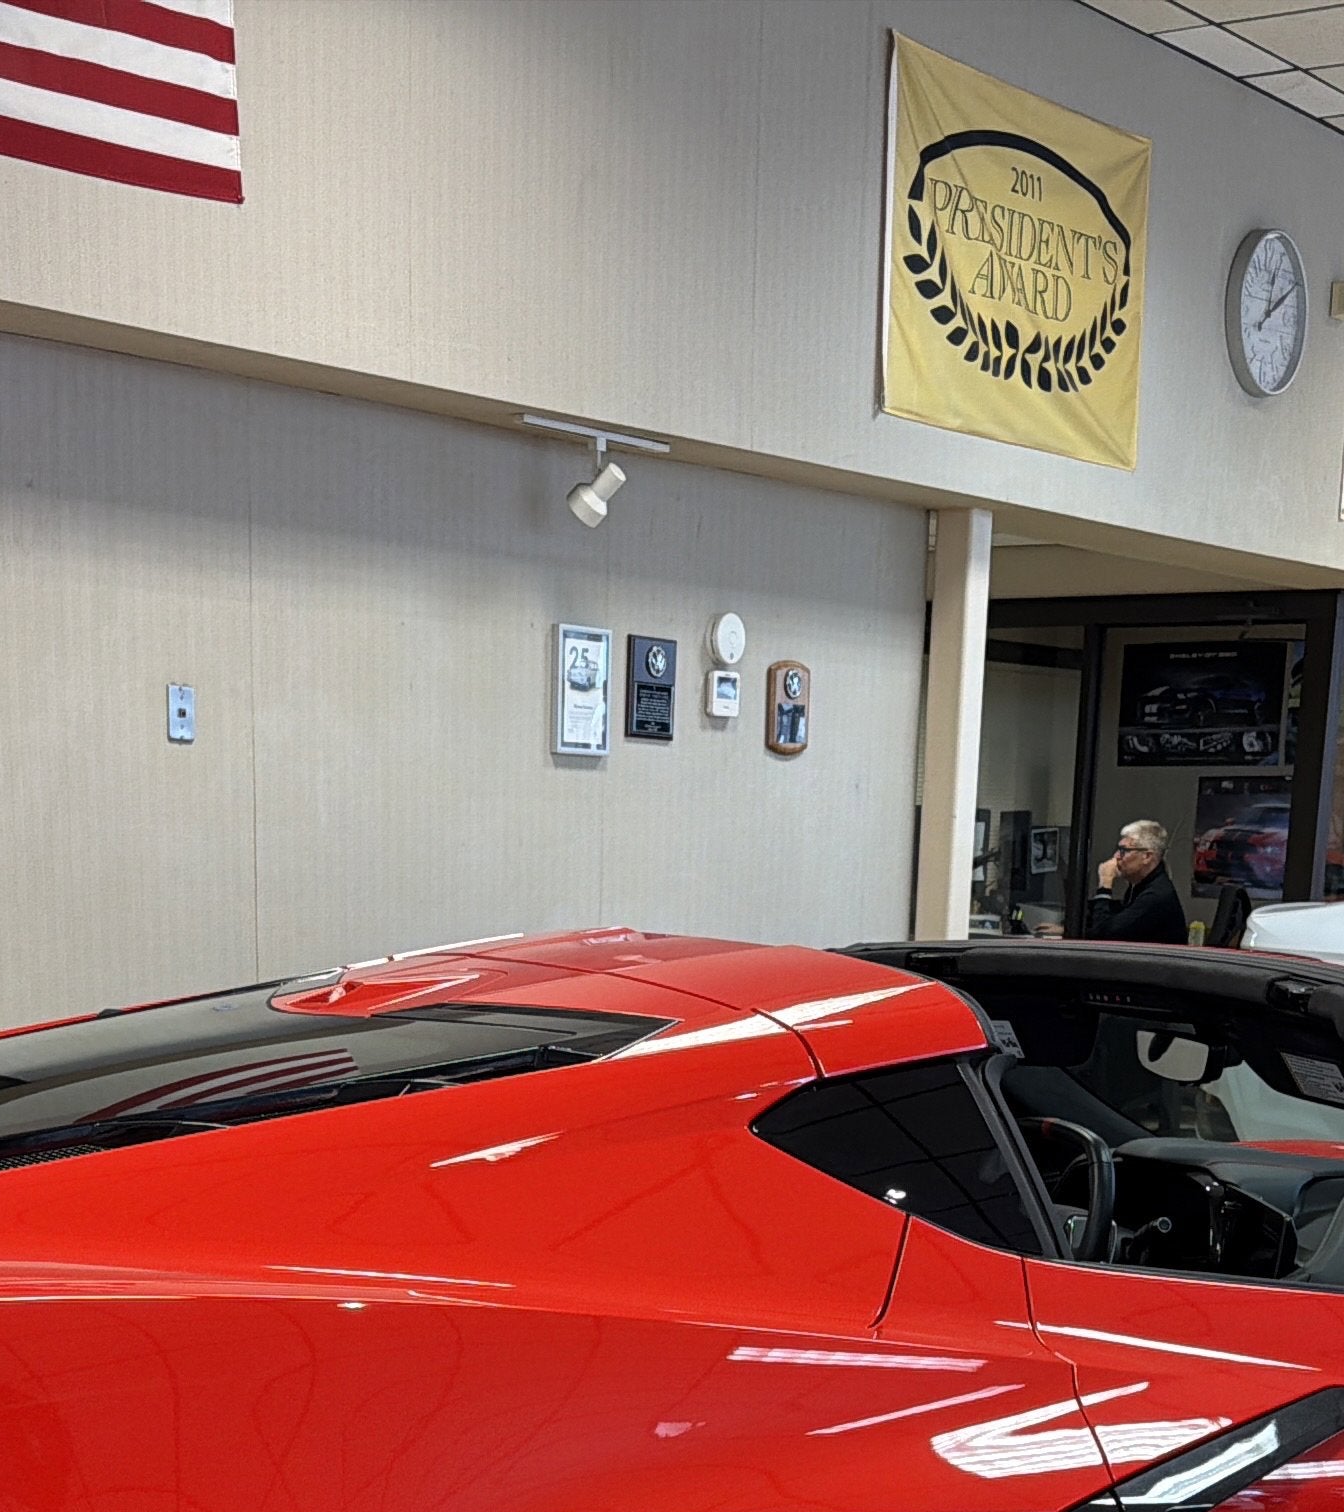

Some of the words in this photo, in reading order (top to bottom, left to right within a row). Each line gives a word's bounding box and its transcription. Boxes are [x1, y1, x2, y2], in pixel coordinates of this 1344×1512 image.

[1010, 166, 1044, 202] 2011
[928, 177, 1118, 286] PRESIDENT'S
[967, 248, 1072, 323] AWARD
[568, 646, 590, 669] 25
